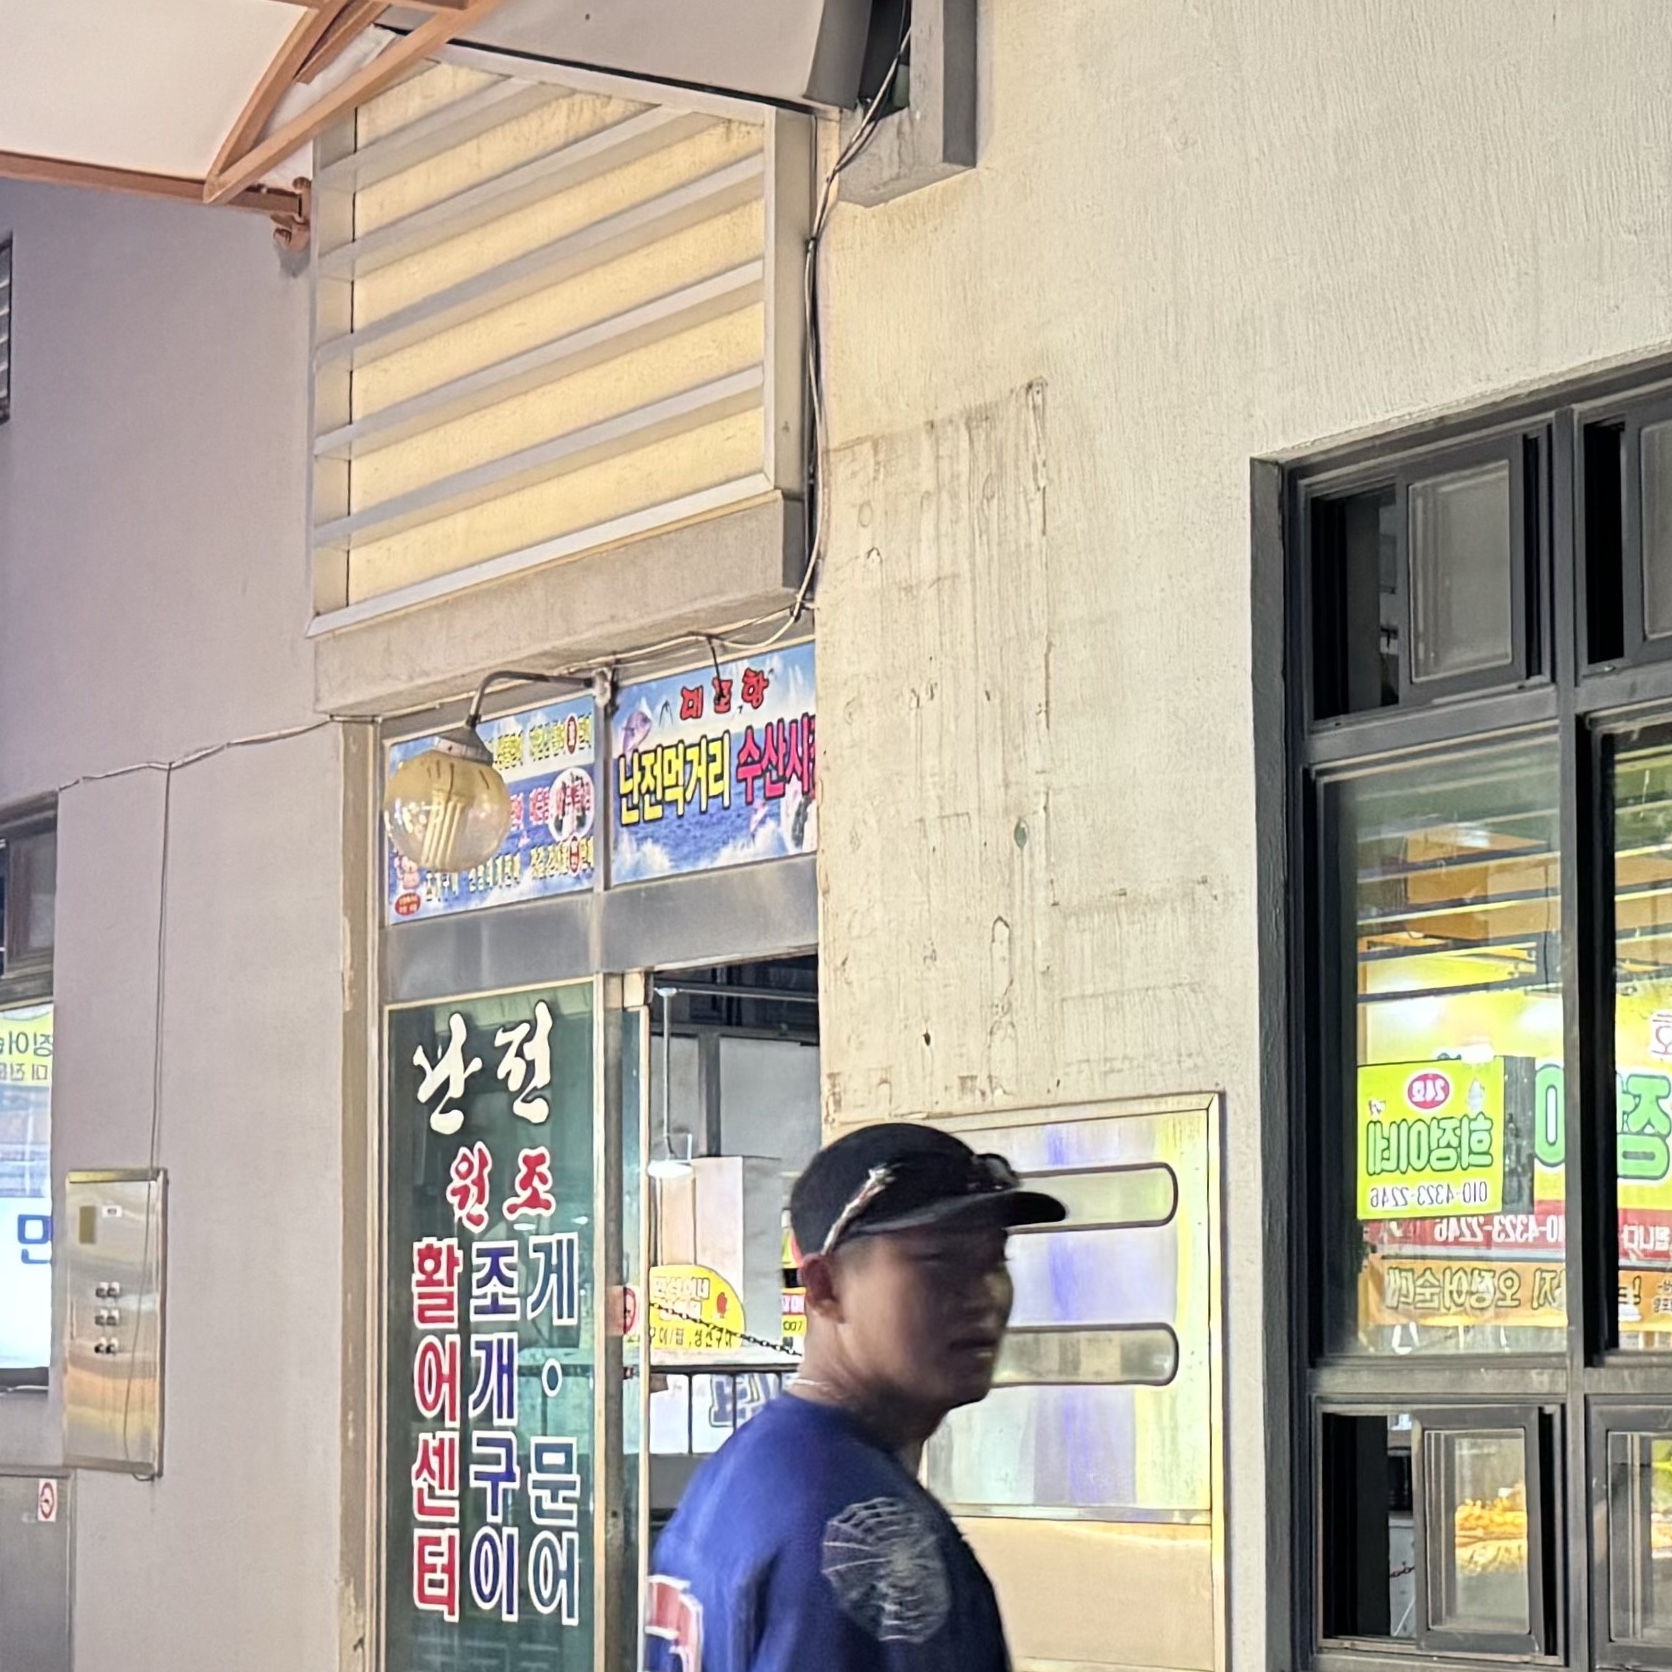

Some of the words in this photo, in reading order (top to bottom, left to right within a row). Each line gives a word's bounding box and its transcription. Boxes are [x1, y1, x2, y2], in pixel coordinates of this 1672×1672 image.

[619, 730, 731, 827] 난전먹거리
[736, 712, 816, 805] 수산시
[413, 1000, 553, 1135] 난전
[446, 1140, 556, 1233] 원조
[412, 1236, 463, 1623] 활어센터
[469, 1239, 521, 1623] 조개구이
